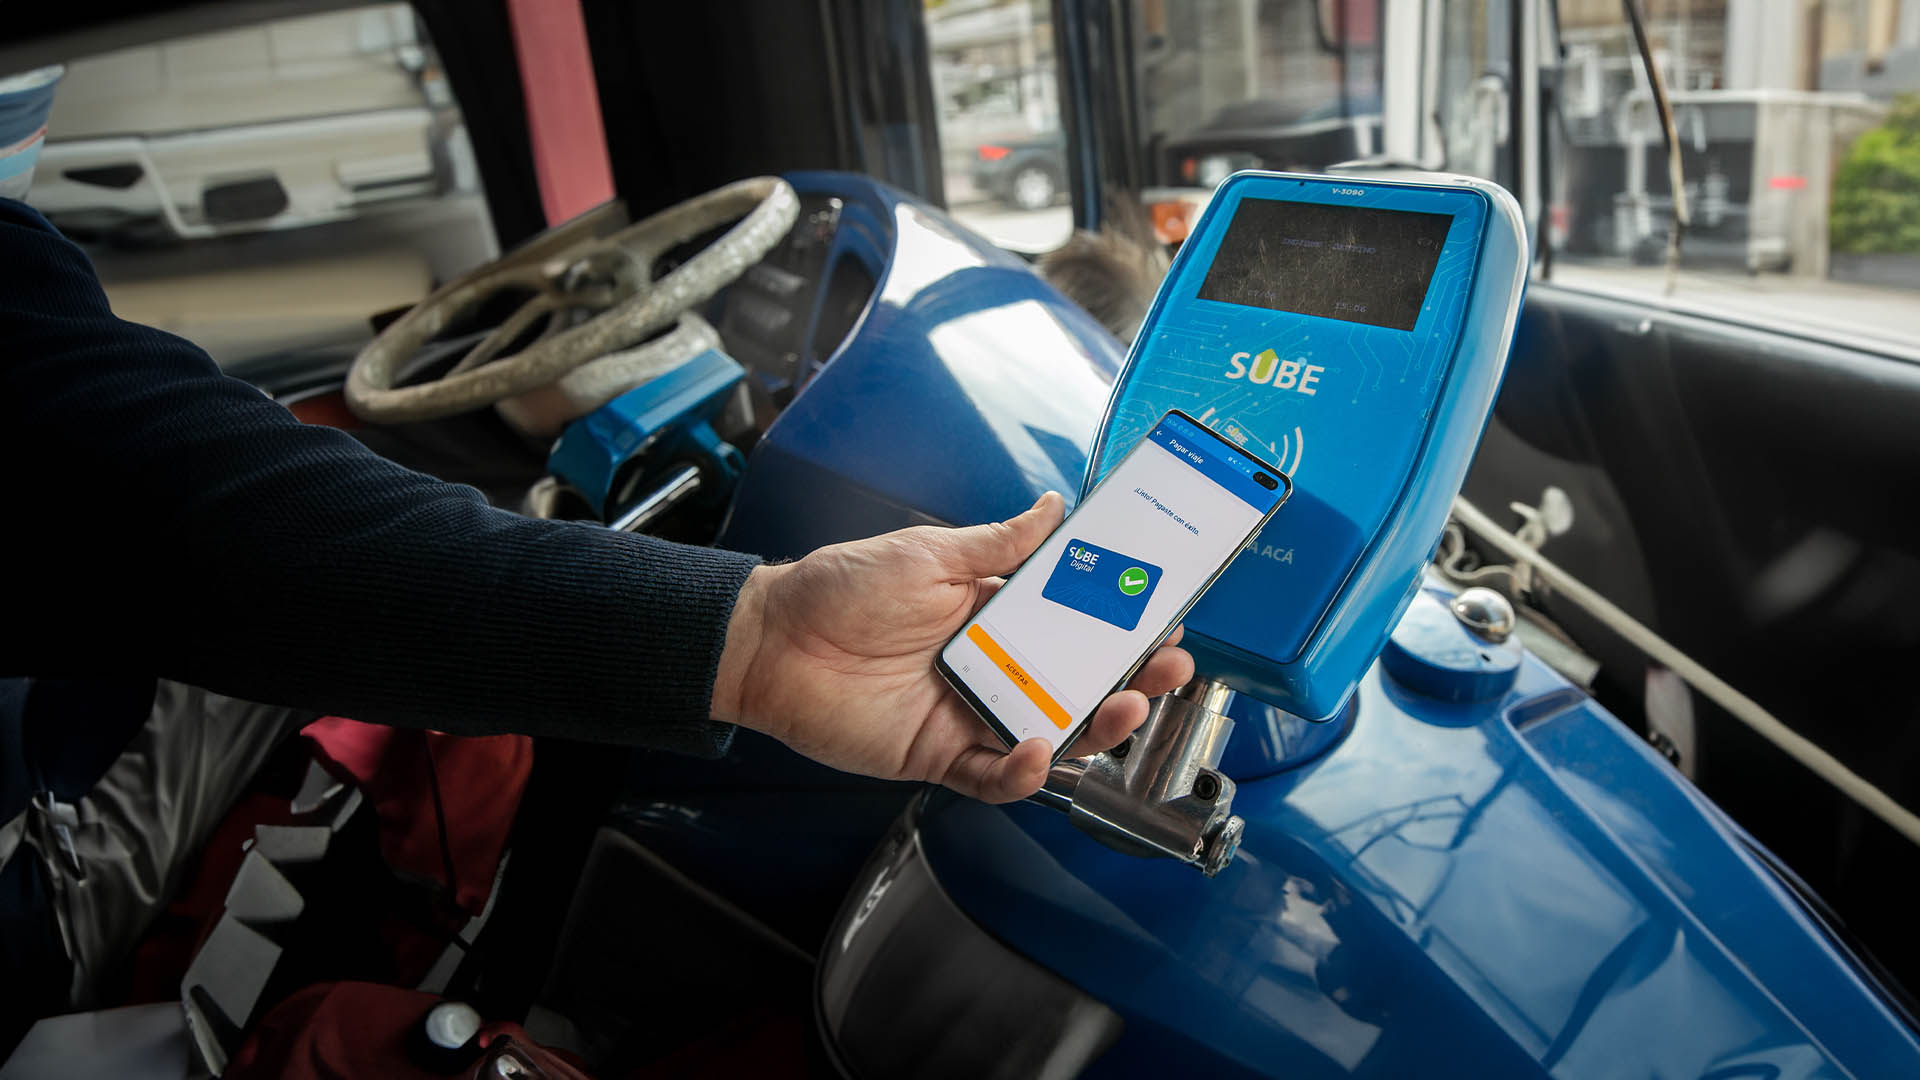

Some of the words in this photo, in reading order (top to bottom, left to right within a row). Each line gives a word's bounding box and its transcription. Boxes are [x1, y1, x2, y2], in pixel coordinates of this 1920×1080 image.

[1224, 348, 1325, 397] SUBE
[1224, 424, 1249, 446] SUBE
[1168, 439, 1189, 455] Pagar
[1187, 452, 1204, 465] viaje
[1151, 498, 1174, 517] Pagaste
[1173, 515, 1185, 525] con
[1069, 546, 1100, 566] SUBE
[1070, 559, 1095, 573] Digital
[1260, 544, 1295, 566] ACÁ
[1005, 663, 1030, 686] ACEPTAR
